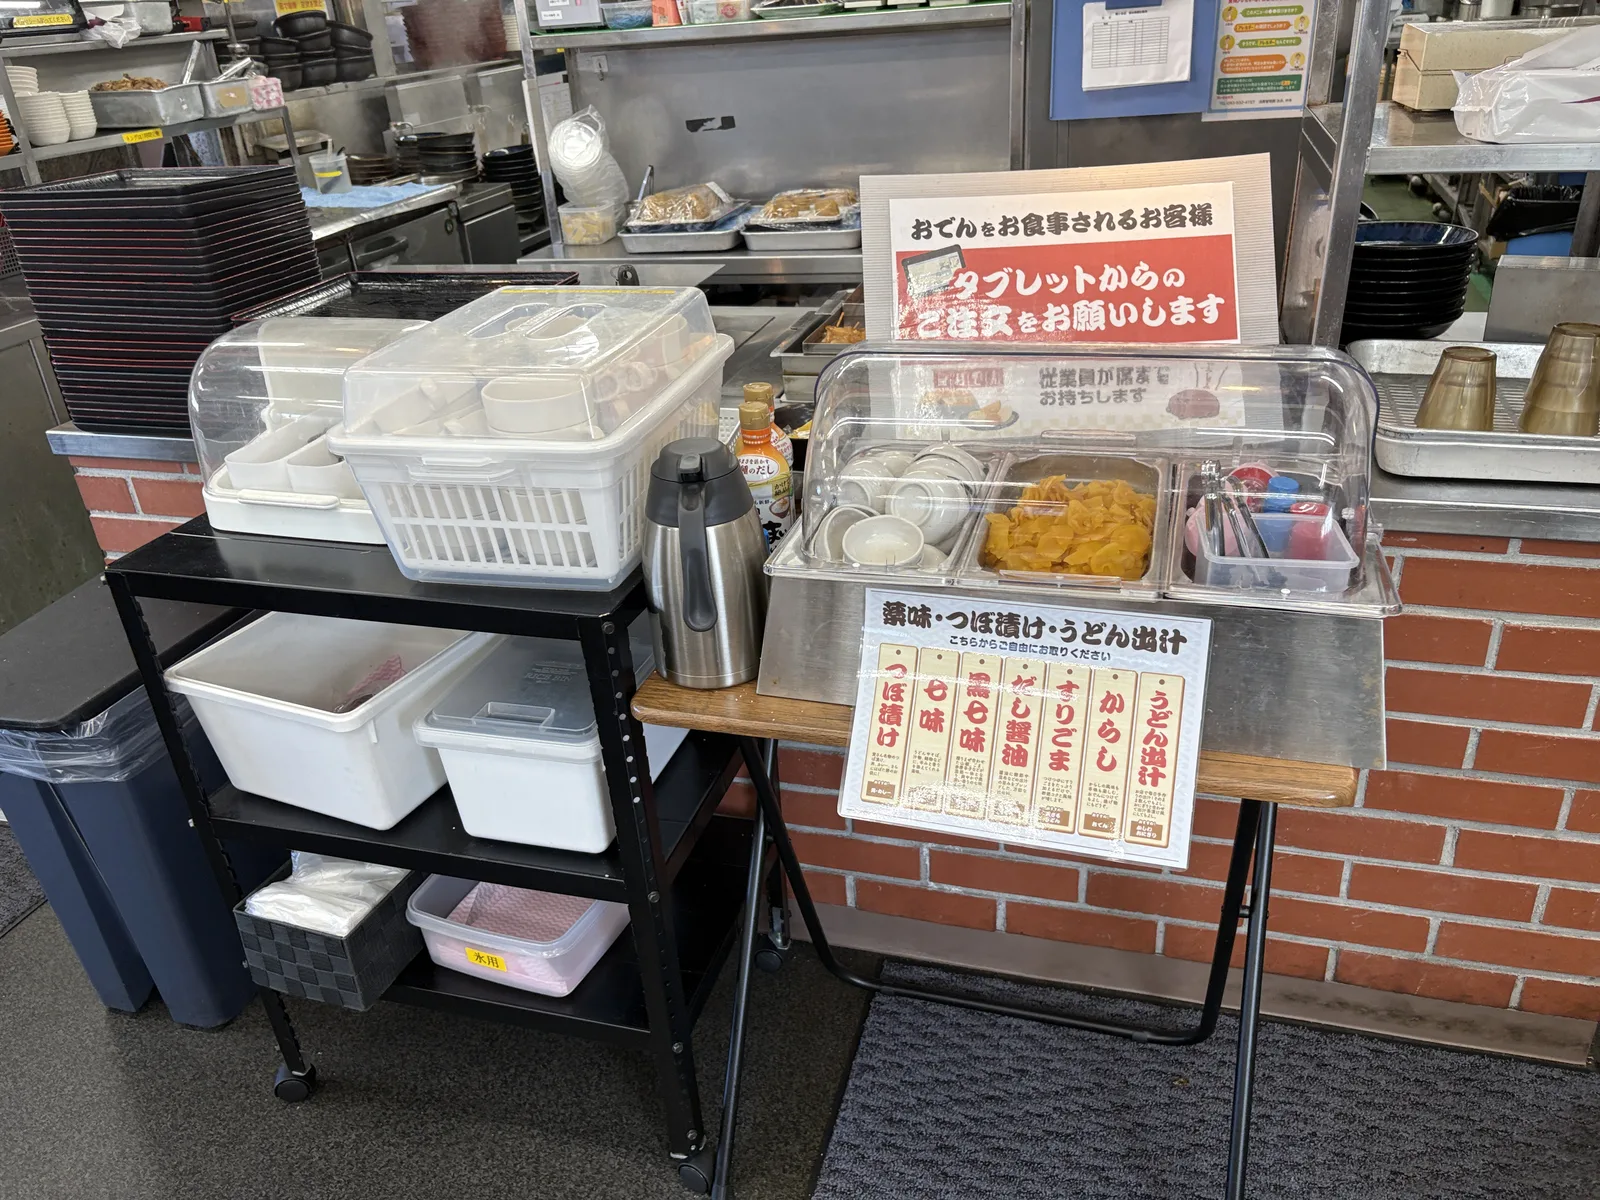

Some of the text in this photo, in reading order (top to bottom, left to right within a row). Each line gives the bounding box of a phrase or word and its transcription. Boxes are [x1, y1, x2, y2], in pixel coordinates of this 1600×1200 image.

[911, 204, 1212, 240] おでんをお食事されるお客様
[949, 264, 1185, 299] タブレットからの
[916, 294, 1225, 338] ご注文をお願いします
[1039, 366, 1170, 389] 従業員が席まで
[1040, 388, 1147, 406] お持ちします
[883, 601, 1187, 655] 薬味・つぼ漬け・うどん出汁
[950, 636, 1111, 661] こちらからご自由にお取りください
[877, 664, 907, 747] つぼ漬け
[920, 679, 948, 733] 七味
[960, 672, 991, 753] 黒七味
[1002, 675, 1037, 768] だし醤油
[1049, 680, 1080, 772] すりごま
[1096, 690, 1125, 772] からし
[1138, 690, 1173, 787] うどん出汁
[474, 952, 499, 968] 氷用
